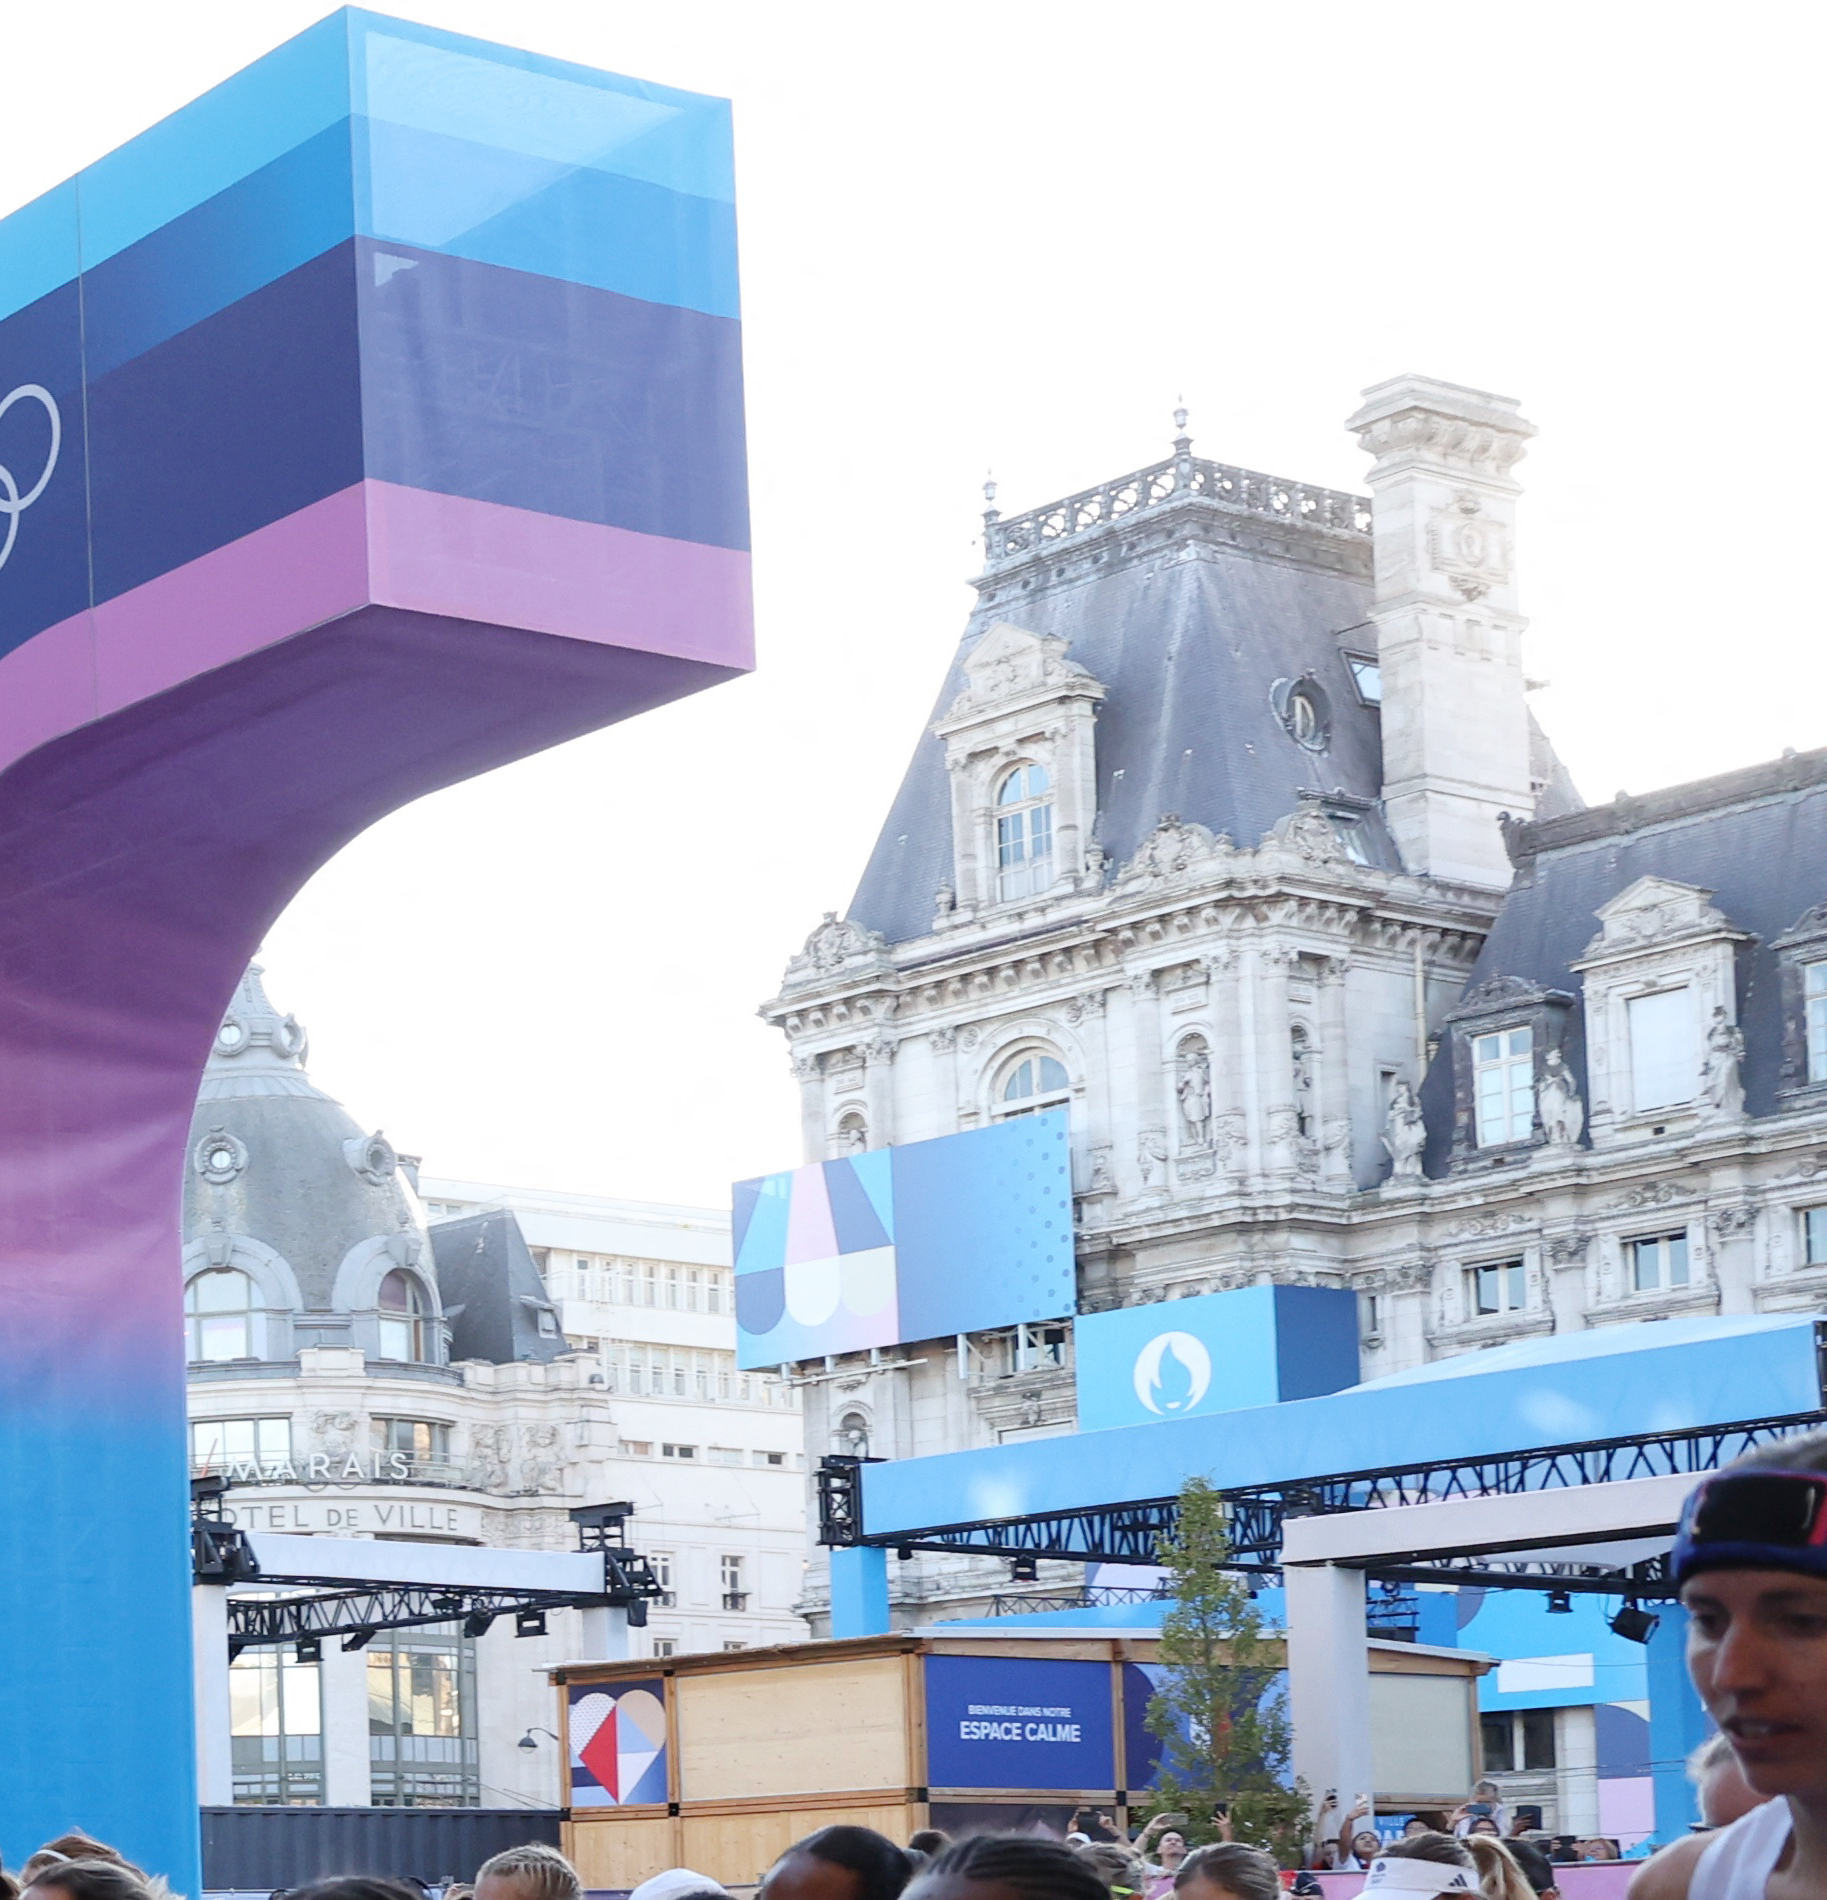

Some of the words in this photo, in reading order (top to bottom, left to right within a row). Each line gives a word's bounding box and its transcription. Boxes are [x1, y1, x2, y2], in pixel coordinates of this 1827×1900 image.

[226, 1451, 410, 1480] MARAIS
[326, 1508, 359, 1527] DE
[373, 1504, 459, 1532] VILLE
[967, 1704, 1017, 1716] BIENVENUE
[1017, 1706, 1042, 1717] DANS
[1042, 1707, 1072, 1718] NOTRE
[959, 1720, 1023, 1741] ESPACE
[1024, 1722, 1082, 1742] CALME
